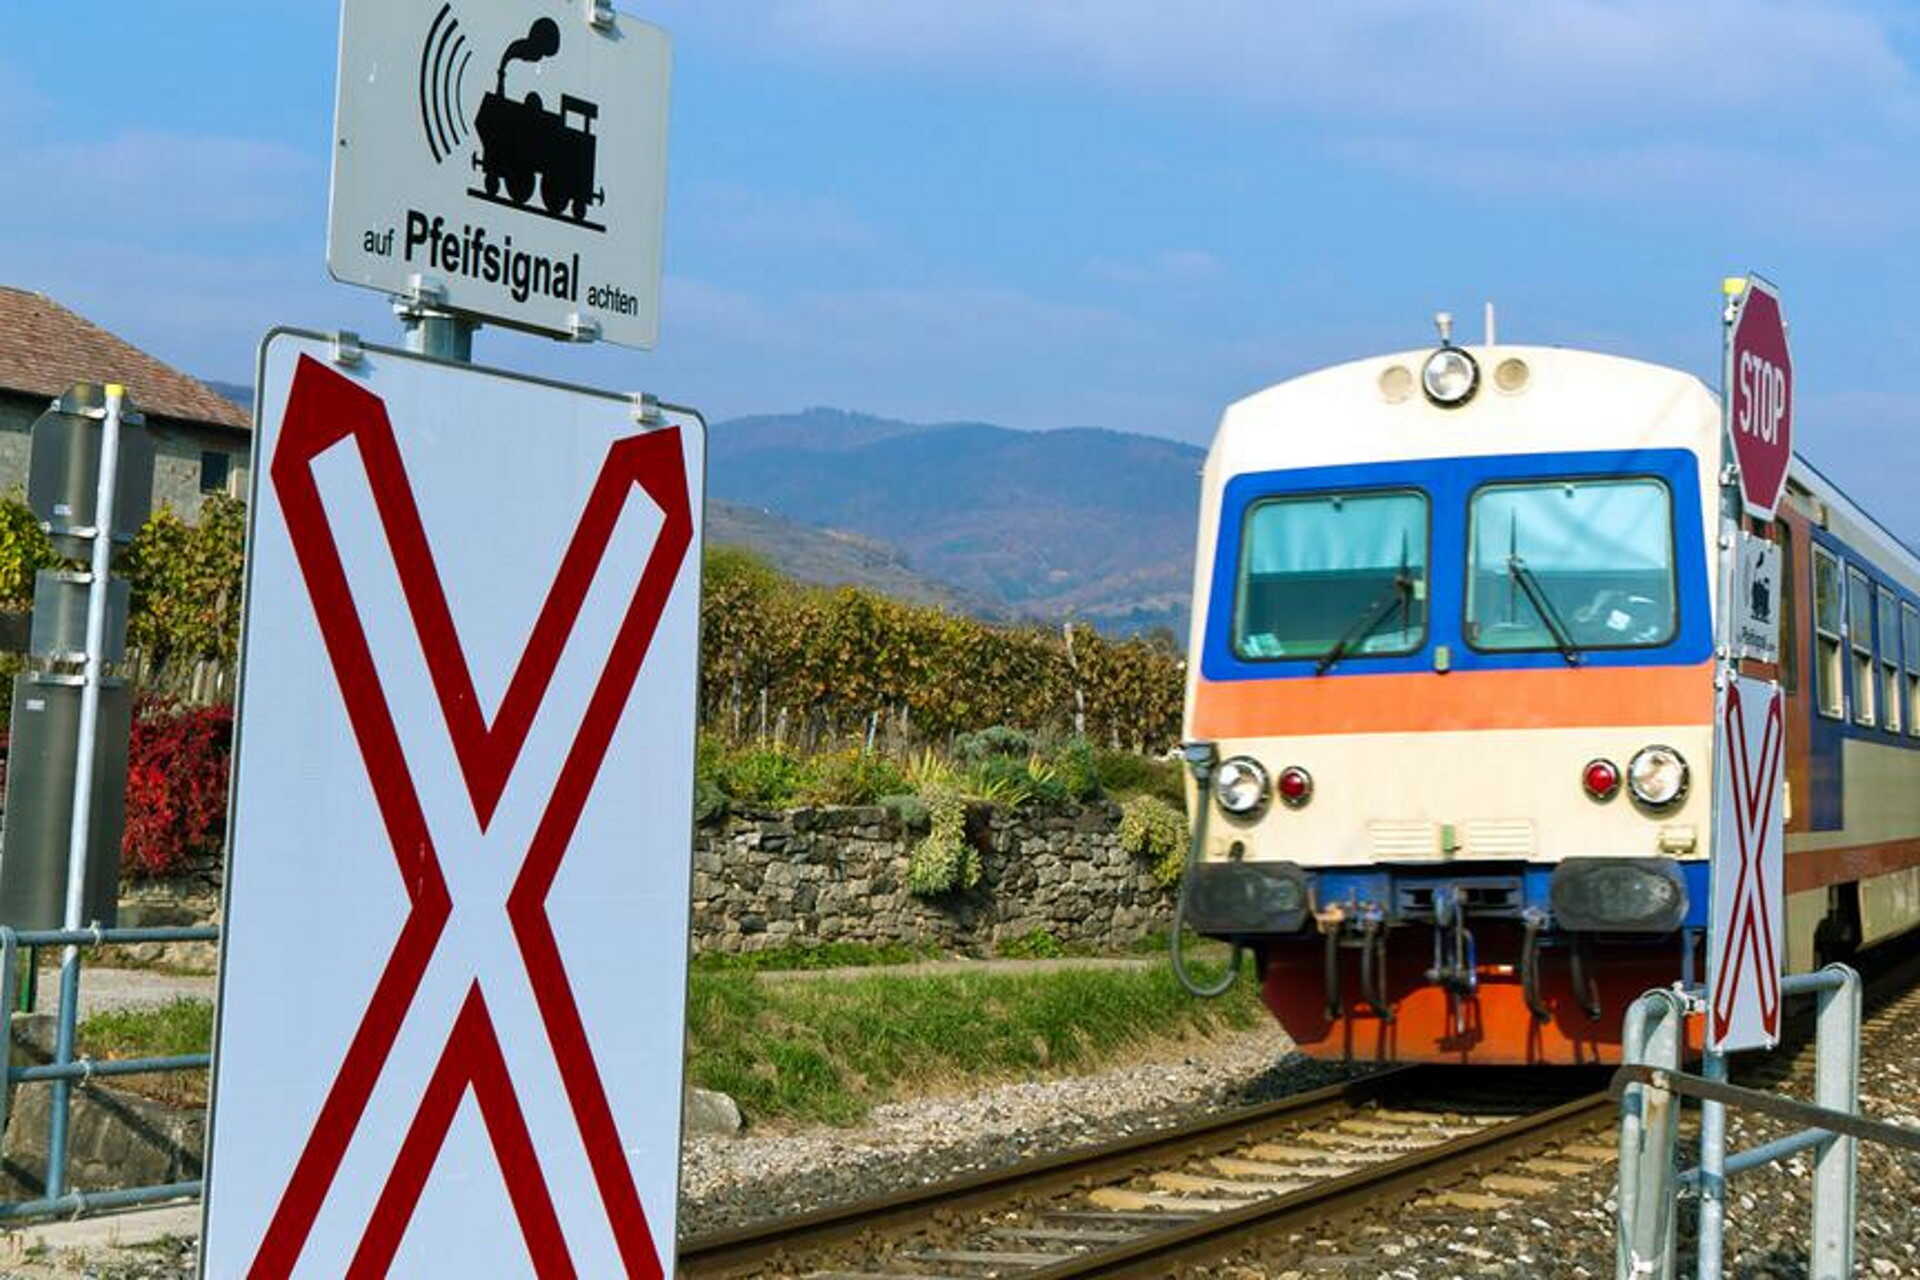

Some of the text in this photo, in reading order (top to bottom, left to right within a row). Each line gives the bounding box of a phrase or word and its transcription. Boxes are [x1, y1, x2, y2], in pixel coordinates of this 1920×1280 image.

[363, 209, 639, 316] auf Pfeifsignal achten
[1740, 349, 1786, 446] STOP
